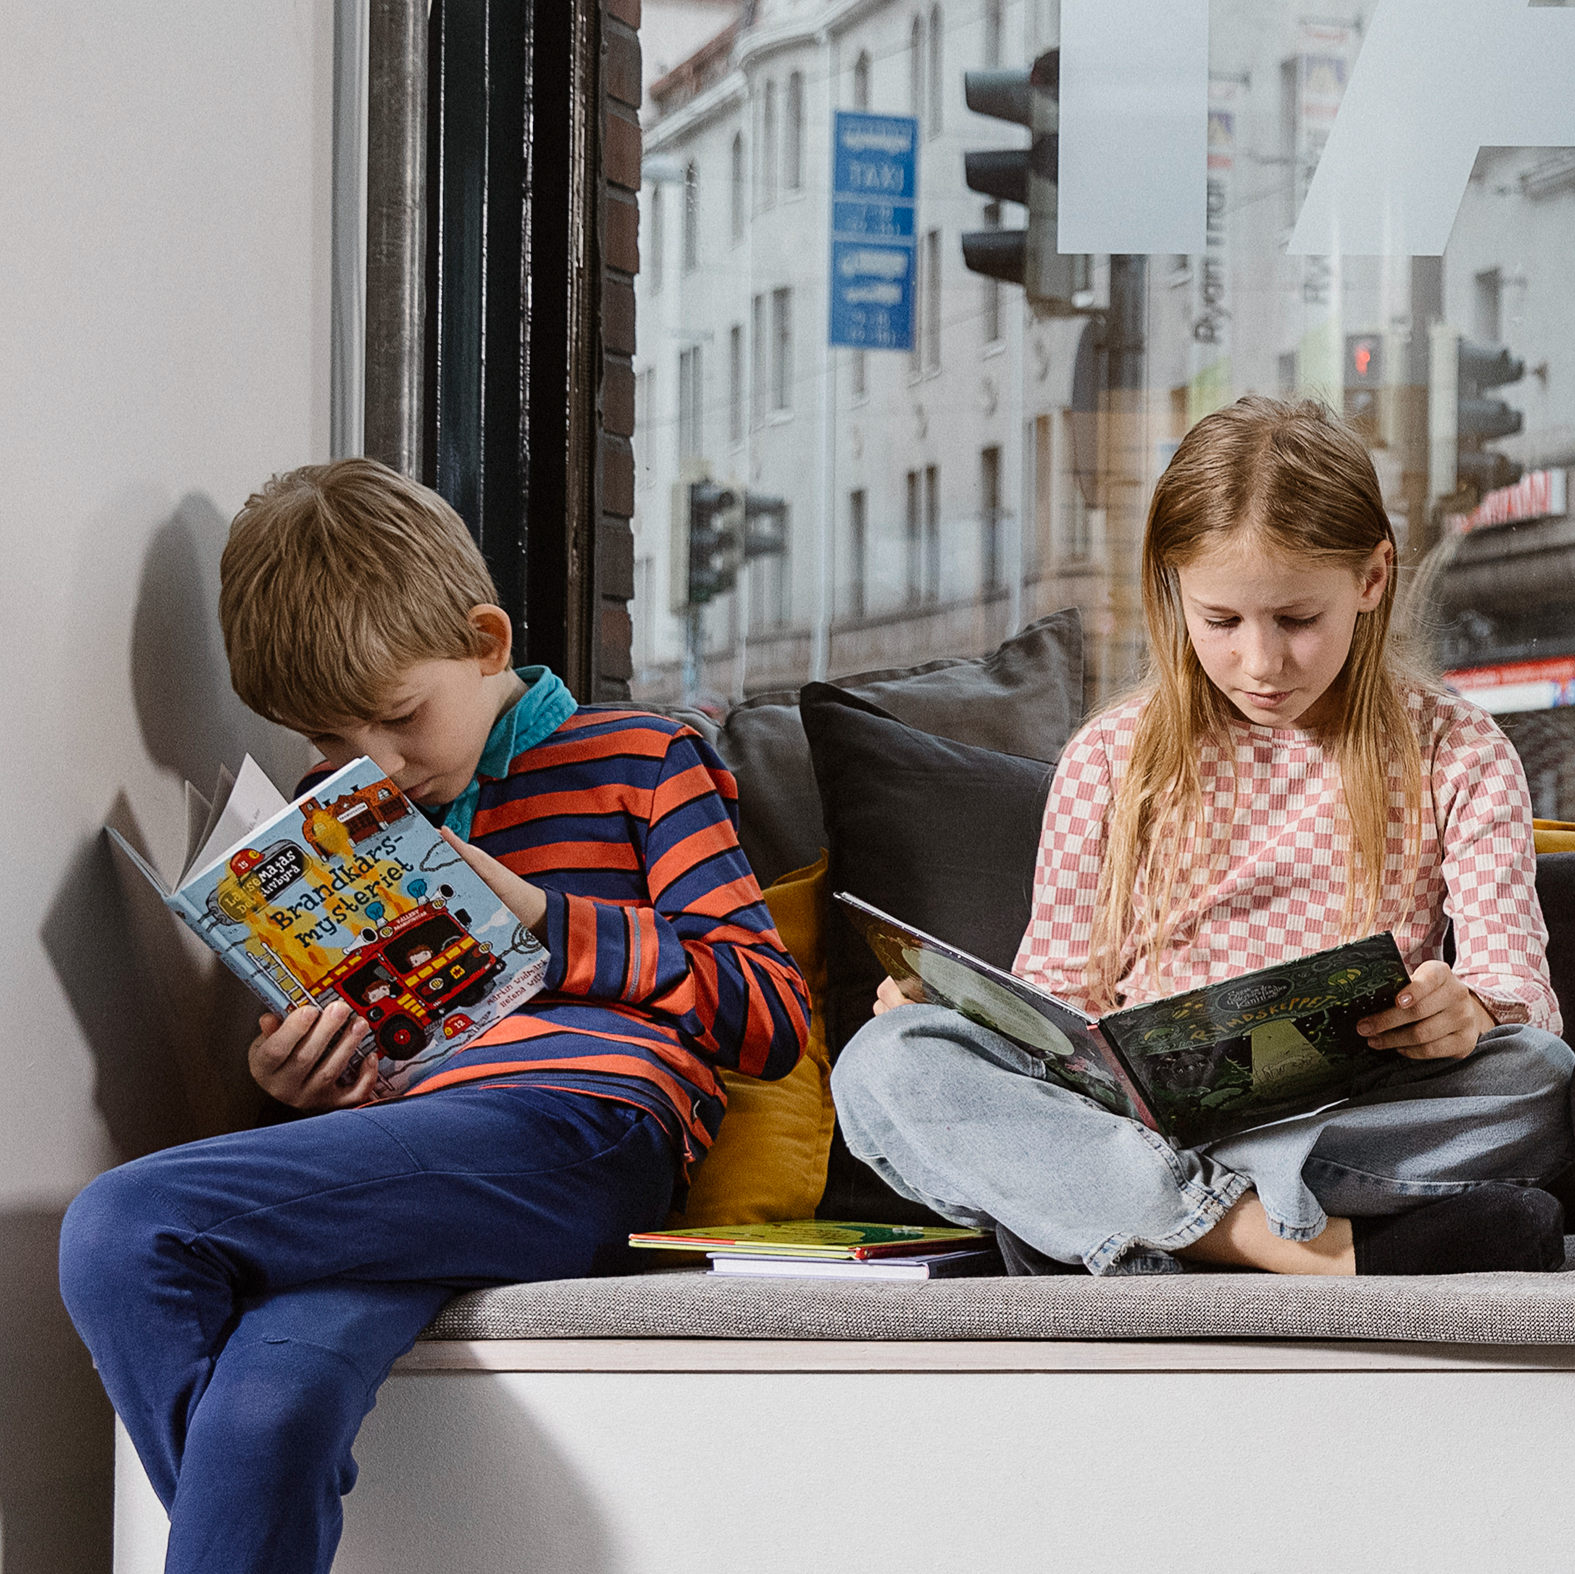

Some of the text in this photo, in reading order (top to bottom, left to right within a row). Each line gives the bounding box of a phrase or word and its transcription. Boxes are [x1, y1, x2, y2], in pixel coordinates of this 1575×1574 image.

[239, 860, 248, 870] 15
[271, 834, 405, 932] Brandkårs-
[296, 861, 414, 948] mysteriet
[454, 1019, 464, 1029] 12
